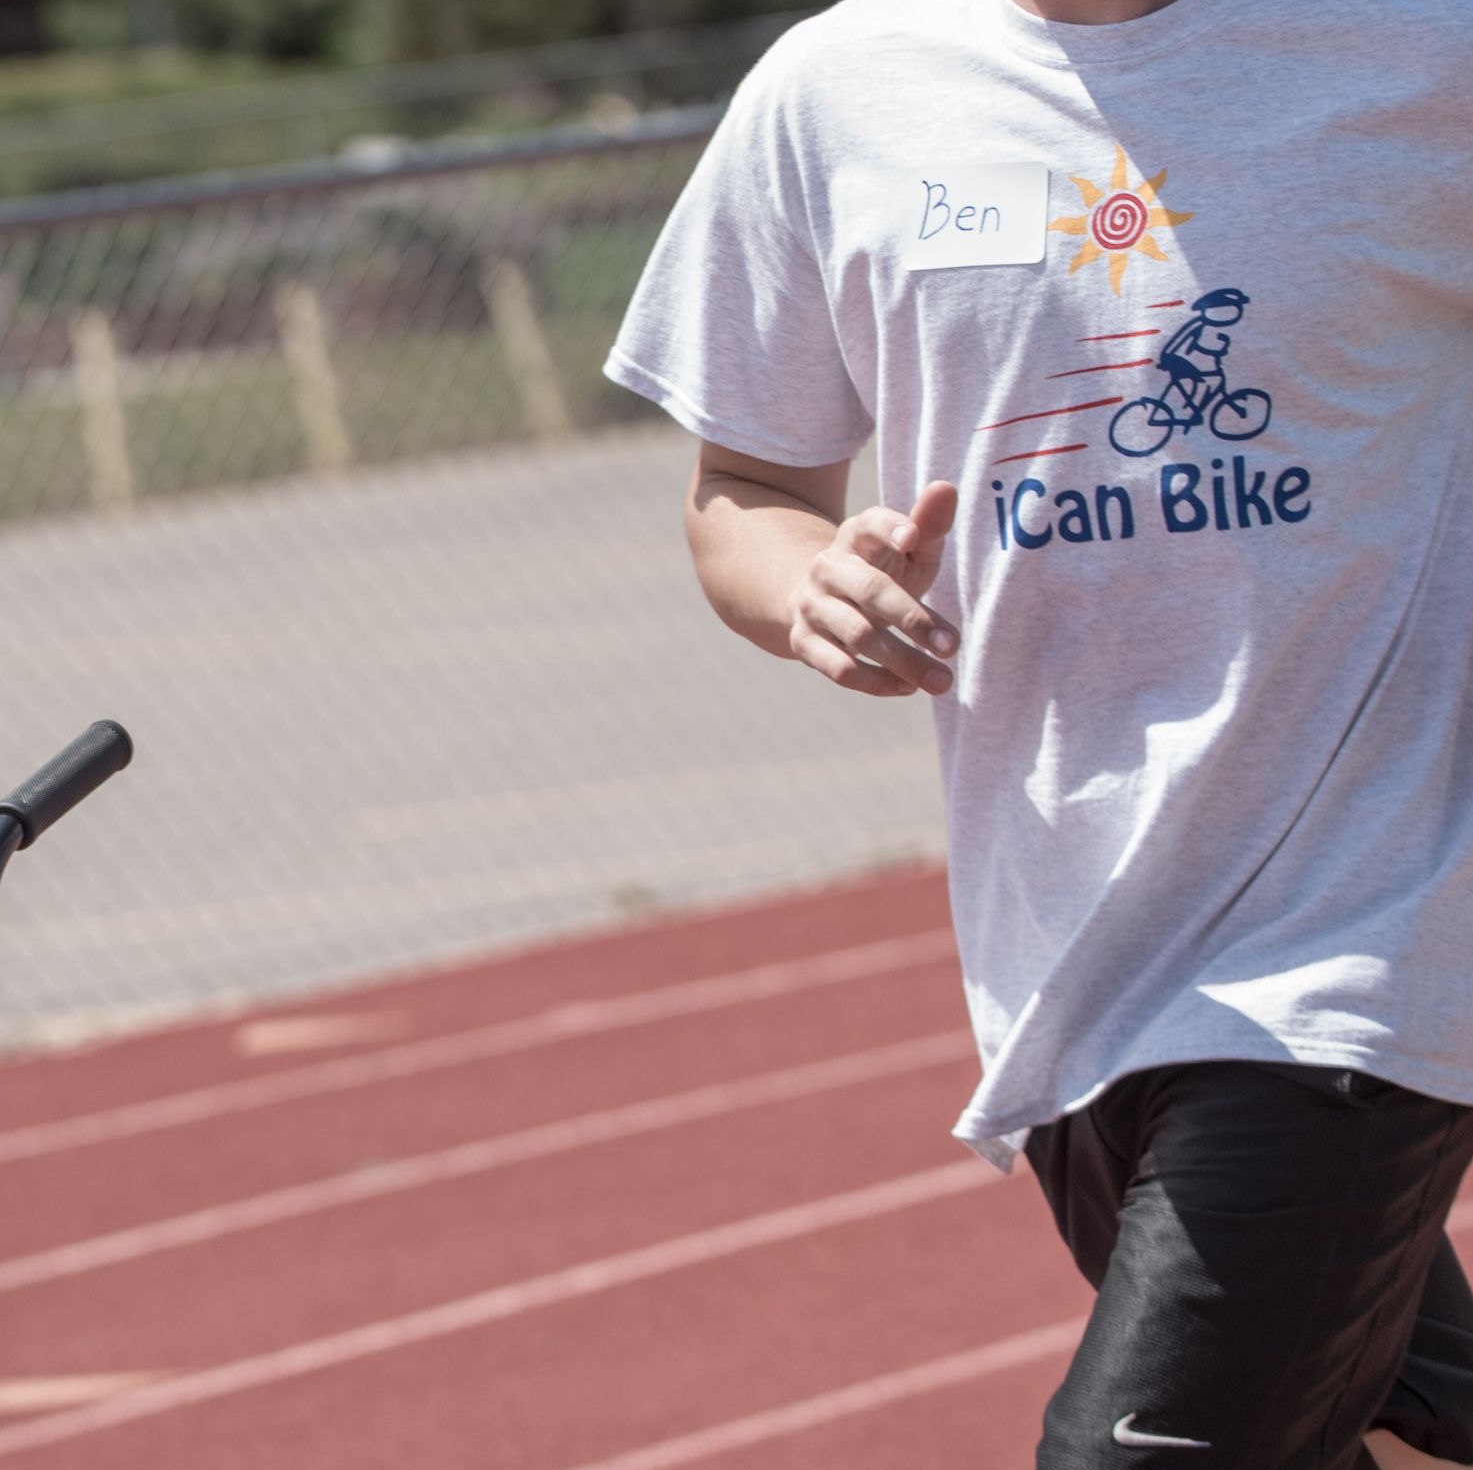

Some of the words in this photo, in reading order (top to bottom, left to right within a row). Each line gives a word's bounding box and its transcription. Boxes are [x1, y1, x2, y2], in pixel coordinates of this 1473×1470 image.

[919, 181, 1001, 240] Ben
[991, 478, 1135, 551] iCan
[1161, 455, 1312, 534] Bike
